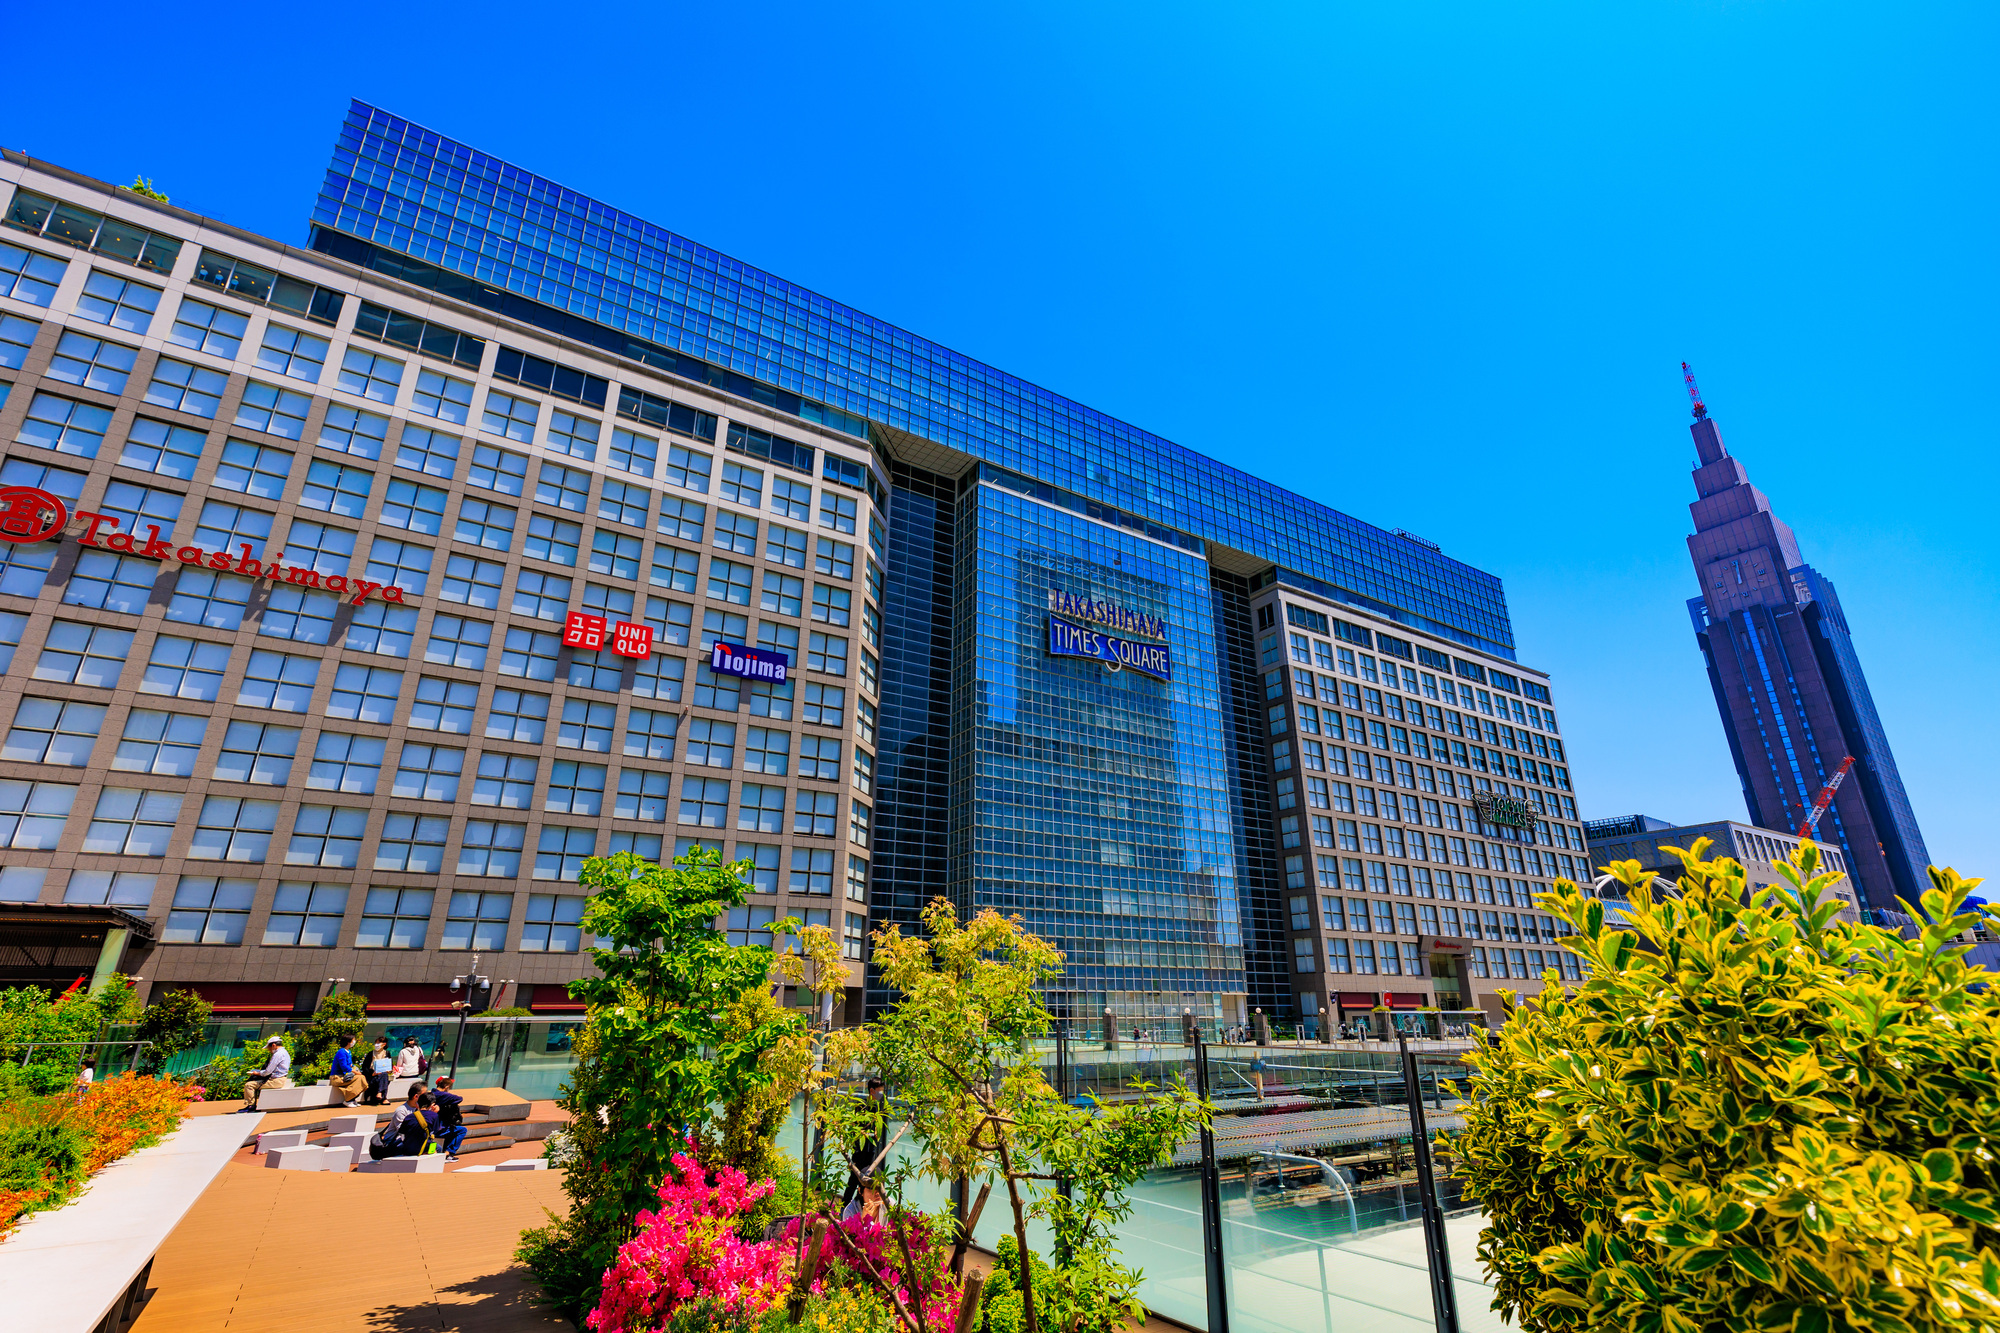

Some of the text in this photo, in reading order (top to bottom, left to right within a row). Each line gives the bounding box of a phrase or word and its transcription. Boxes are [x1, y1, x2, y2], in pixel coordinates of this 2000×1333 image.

[74, 510, 404, 606] Takashimaya
[1053, 588, 1166, 639] TAKASHIMAYA
[571, 616, 601, 632] ユニ
[568, 630, 599, 646] クロ
[619, 625, 646, 641] UNI
[617, 639, 647, 655] QLO
[1054, 623, 1168, 673] TIMES SQUARE
